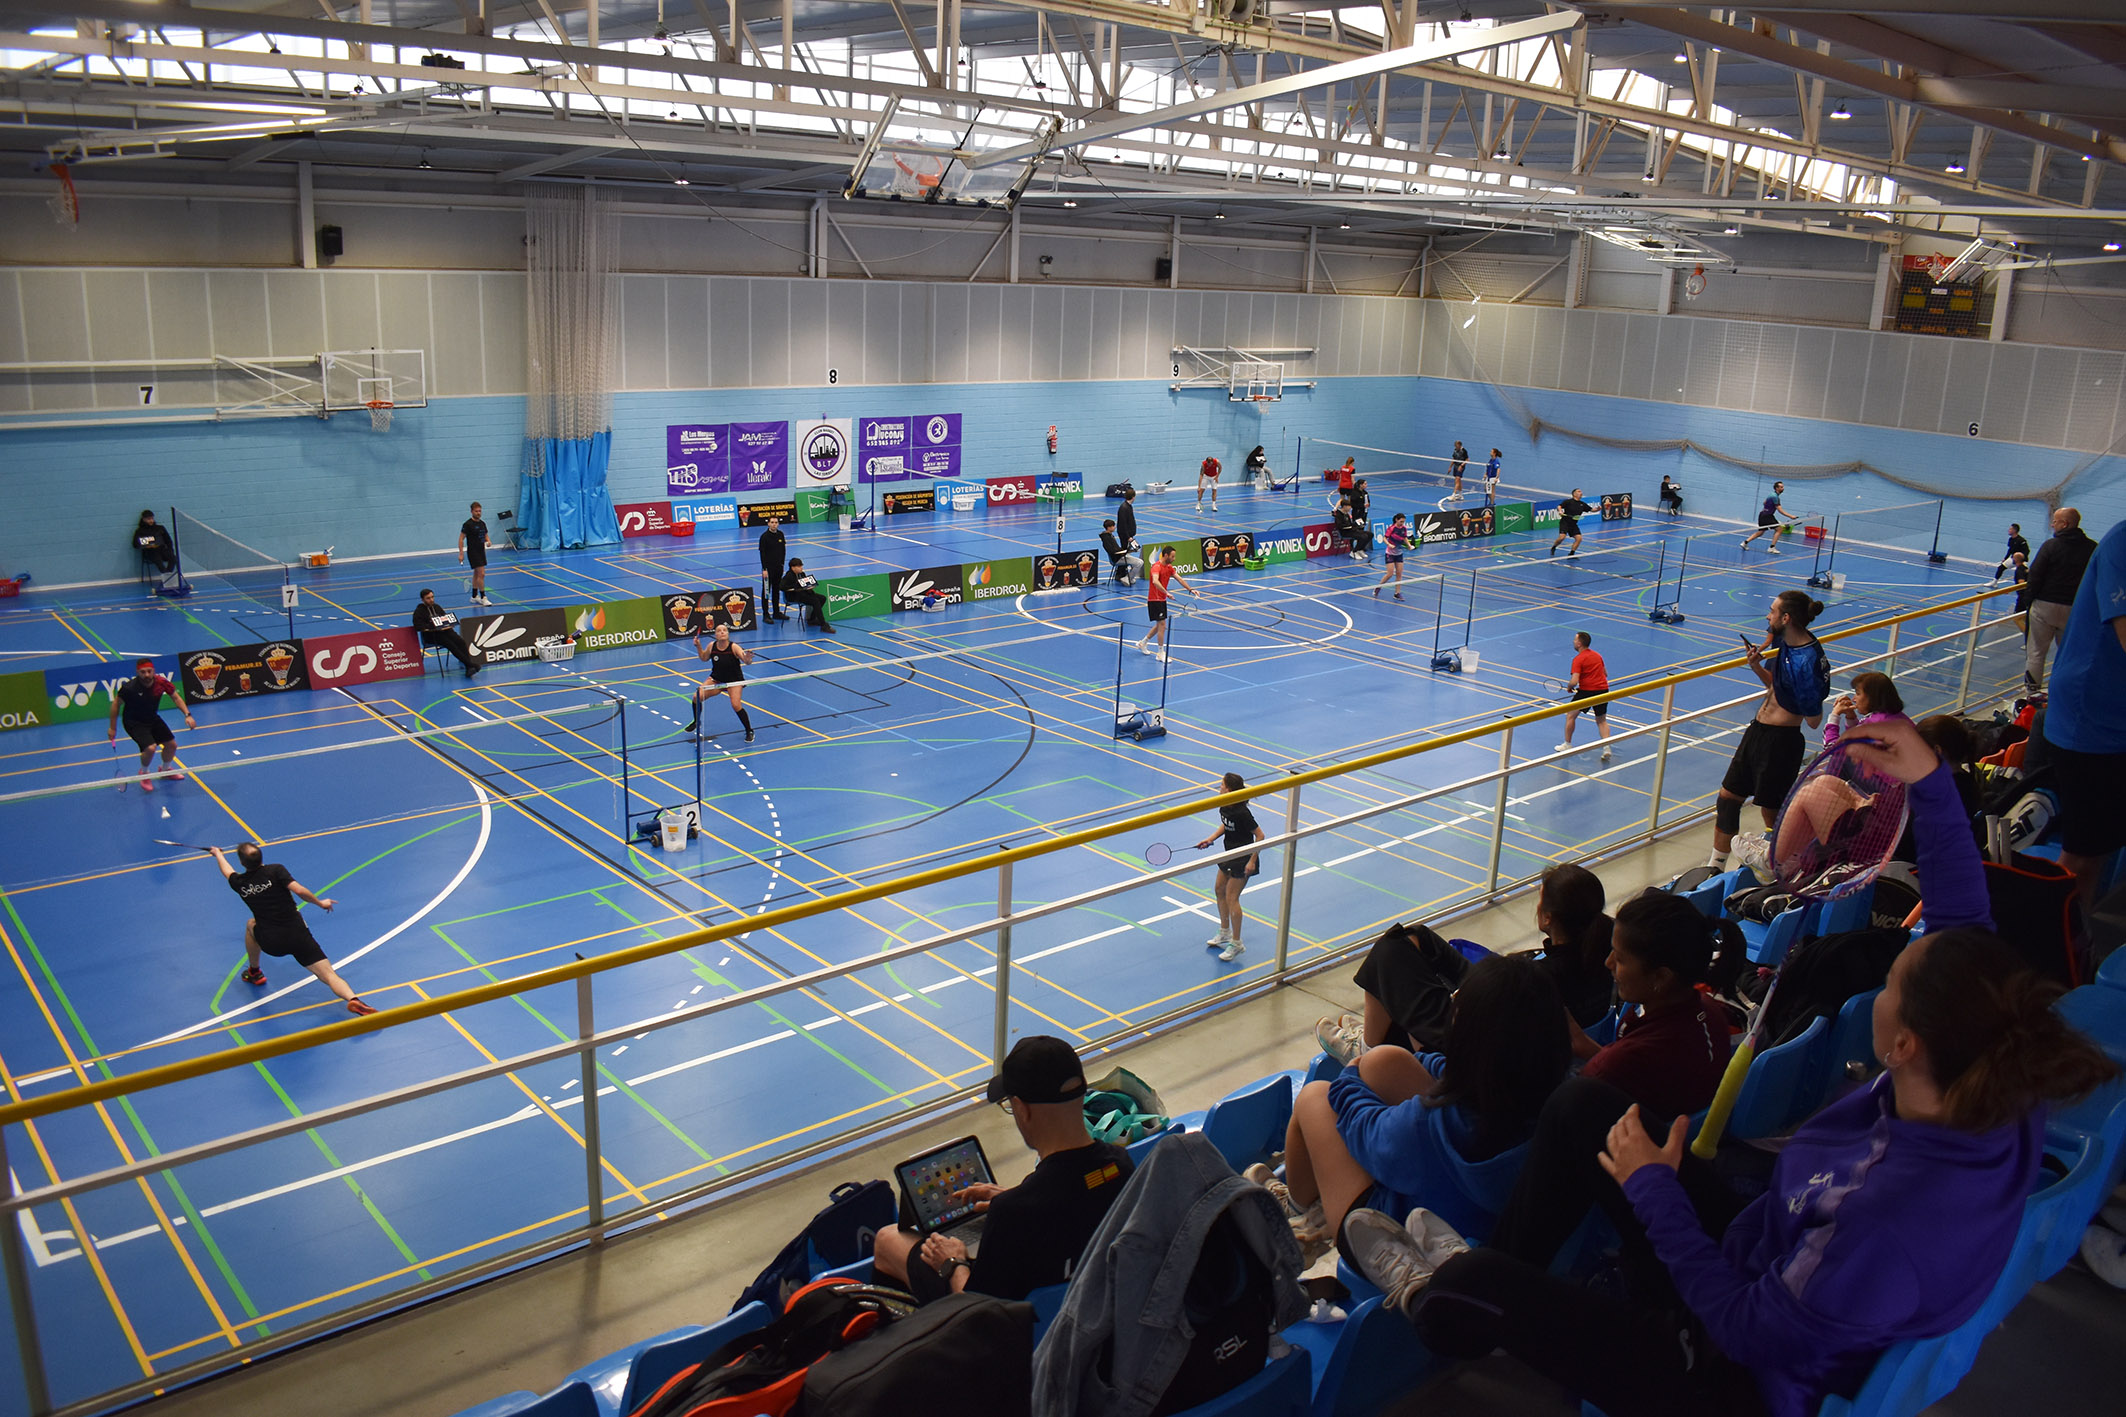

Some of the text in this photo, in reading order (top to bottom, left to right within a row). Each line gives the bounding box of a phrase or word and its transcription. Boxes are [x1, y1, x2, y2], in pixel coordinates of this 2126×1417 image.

[829, 369, 837, 384] 8
[1173, 364, 1179, 377] 9
[140, 386, 153, 404] 7
[1969, 423, 1979, 436] 6
[817, 460, 831, 468] BLT
[952, 486, 984, 494] LOTERÍAS
[694, 502, 734, 514] LOTERÍAS
[1058, 520, 1064, 530] 8
[1423, 532, 1456, 542] BADMINTON
[1274, 538, 1304, 554] YONEX
[286, 590, 294, 603] 7
[974, 583, 1027, 599] IBERDROLA
[585, 628, 658, 648] IBERDROLA
[382, 651, 406, 659] Consejo
[485, 646, 538, 662] BADMIN
[225, 661, 263, 671] FEBAMUR.ES
[384, 657, 408, 666] Superior
[393, 662, 419, 671] Deportes
[1154, 715, 1161, 727] 3
[687, 810, 697, 826] 2
[1871, 910, 1904, 928] VICT
[1213, 1335, 1248, 1363] RSL
